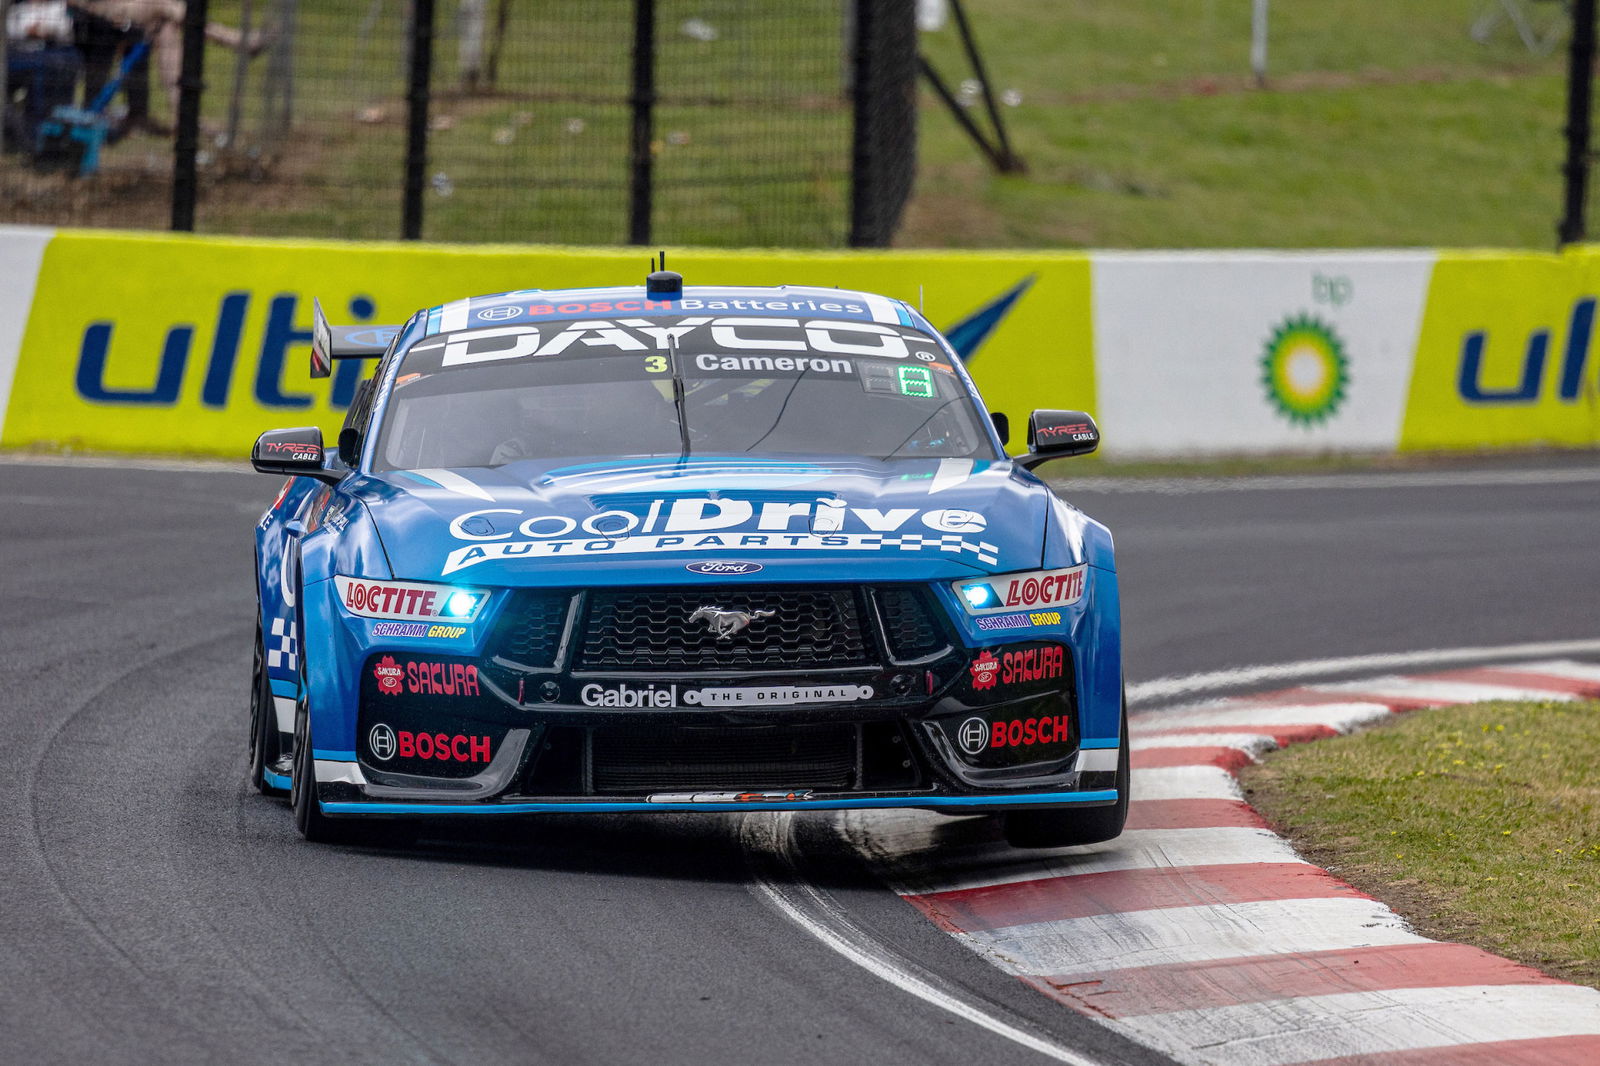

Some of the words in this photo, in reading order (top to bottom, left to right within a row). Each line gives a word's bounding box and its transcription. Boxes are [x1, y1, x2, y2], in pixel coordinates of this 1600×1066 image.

[528, 300, 672, 316] BOSCH
[680, 299, 864, 313] Batteries
[441, 316, 909, 366] DAYCO
[645, 356, 667, 372] 3
[696, 354, 852, 374] Cameron
[1037, 423, 1092, 437] TYREE
[1072, 432, 1094, 441] CABLE
[266, 443, 321, 454] TYREE
[292, 452, 317, 460] CABLE
[449, 497, 988, 541] CoolDrive
[458, 540, 617, 566] AUTO
[655, 534, 850, 548] PARTS
[1005, 570, 1082, 606] LOCTITE
[976, 613, 1030, 630] SCHRAMM
[1030, 612, 1060, 626] GROUP
[372, 623, 427, 637] SCHRAMM
[427, 625, 466, 638] GROUP
[377, 666, 401, 676] SAKURA
[974, 661, 998, 672] SAKURA
[1002, 645, 1063, 684] SAKURA
[407, 661, 480, 696] SAKURA
[581, 683, 677, 707] Gabriel
[710, 692, 743, 700] THE
[757, 689, 847, 700] ORIGINAL
[991, 715, 1069, 748] BOSCH
[398, 731, 491, 762] BOSCH
